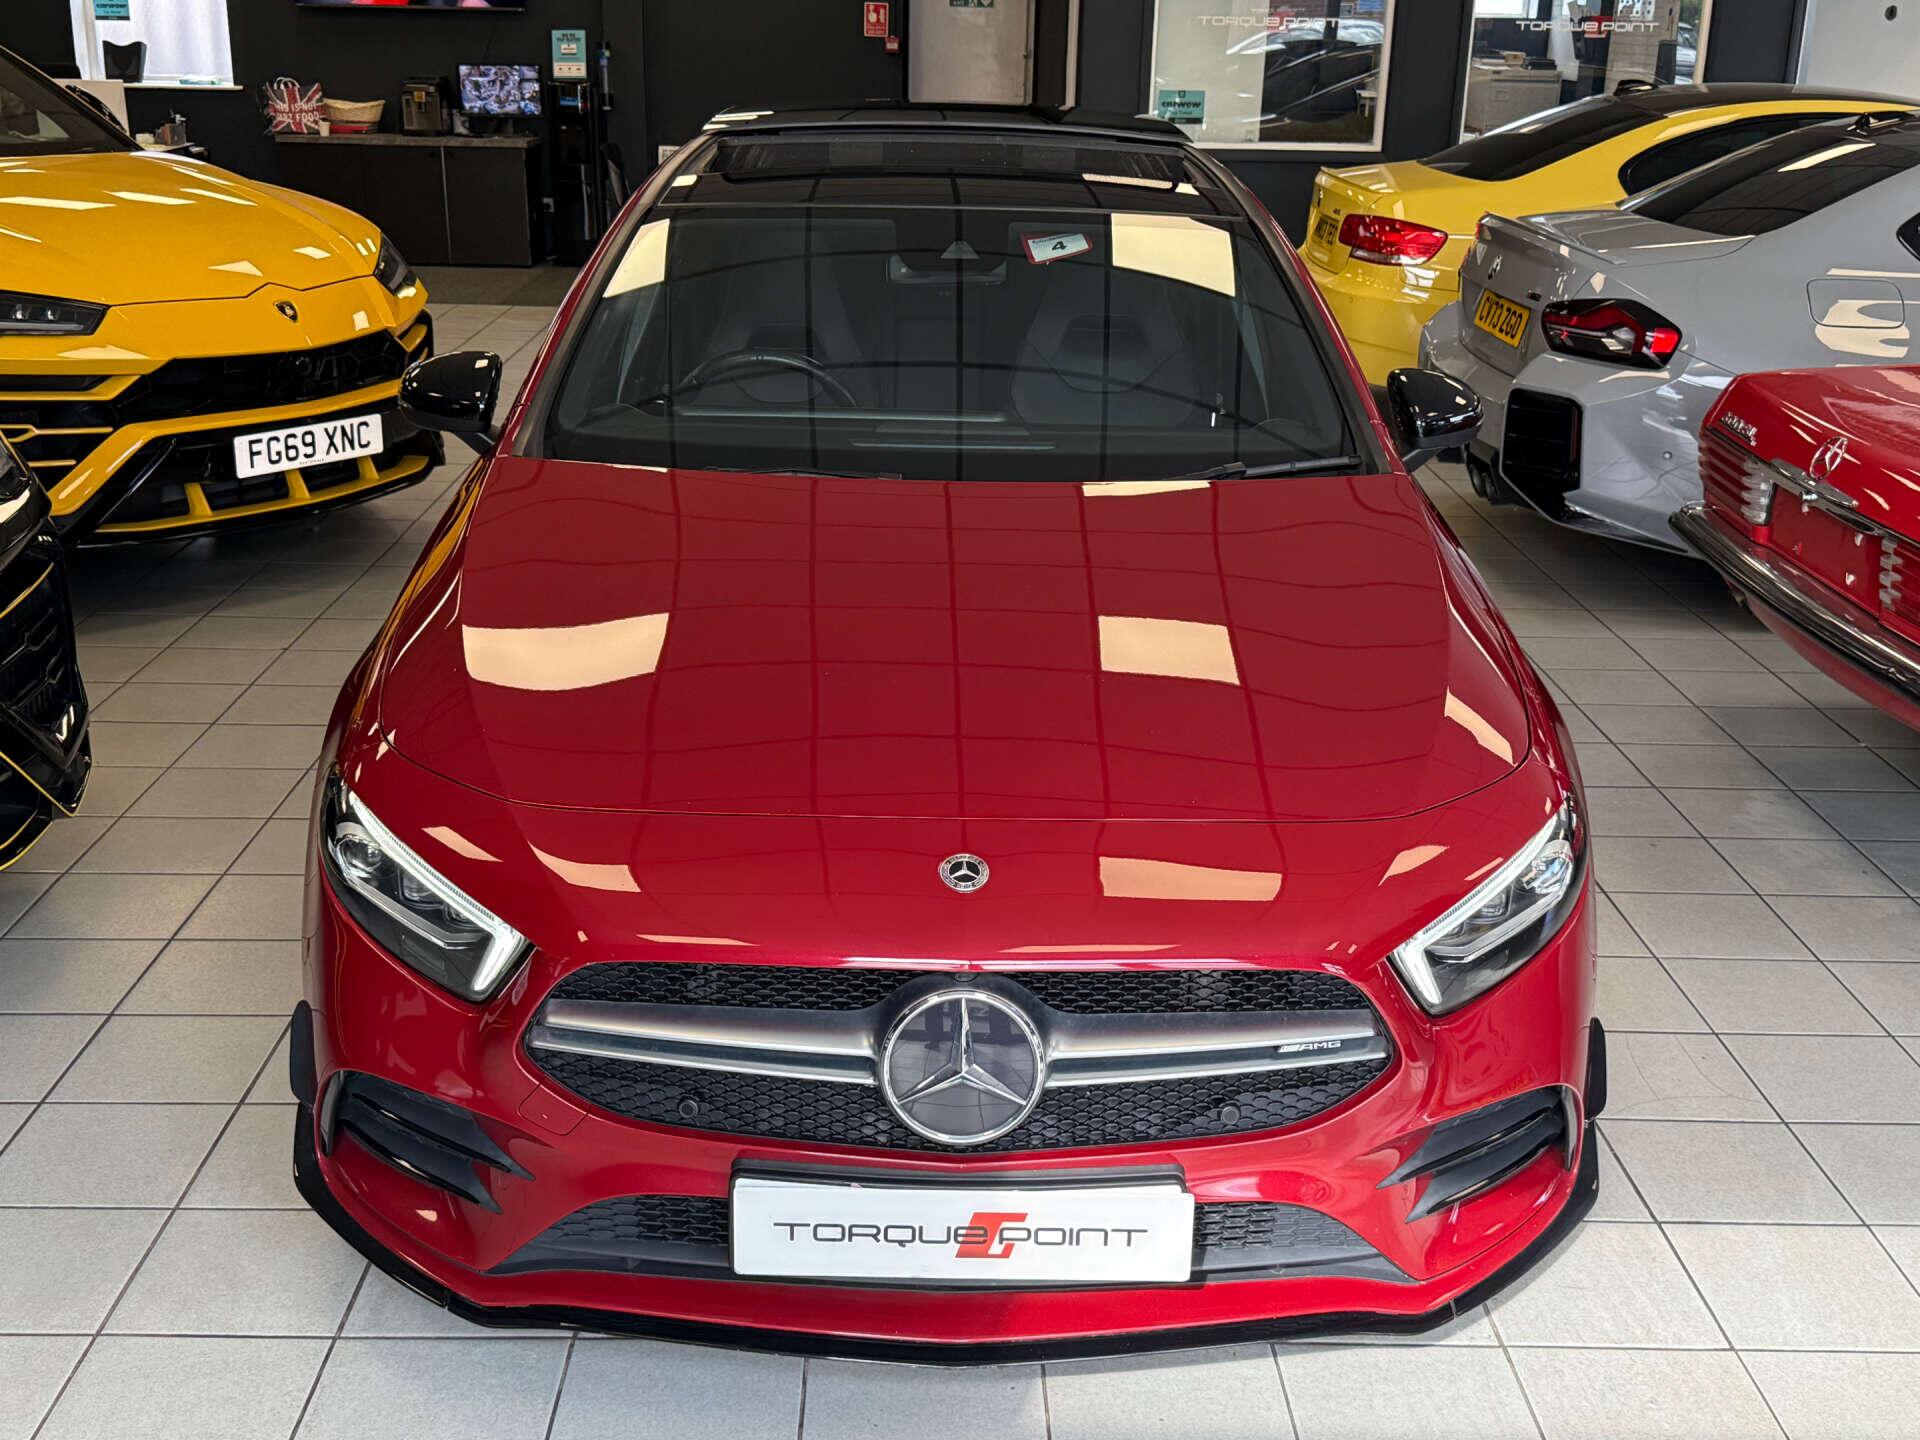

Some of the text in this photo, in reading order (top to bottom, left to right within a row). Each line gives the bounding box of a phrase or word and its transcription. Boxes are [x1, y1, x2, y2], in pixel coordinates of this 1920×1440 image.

[1198, 15, 1340, 29] TORQUE POINT
[1515, 20, 1659, 32] TORQUE POINT
[1052, 240, 1067, 251] 4
[248, 420, 371, 469] FG69 XNC
[1298, 1040, 1342, 1052] AMG
[773, 1221, 1148, 1248] TORQUE POINT
